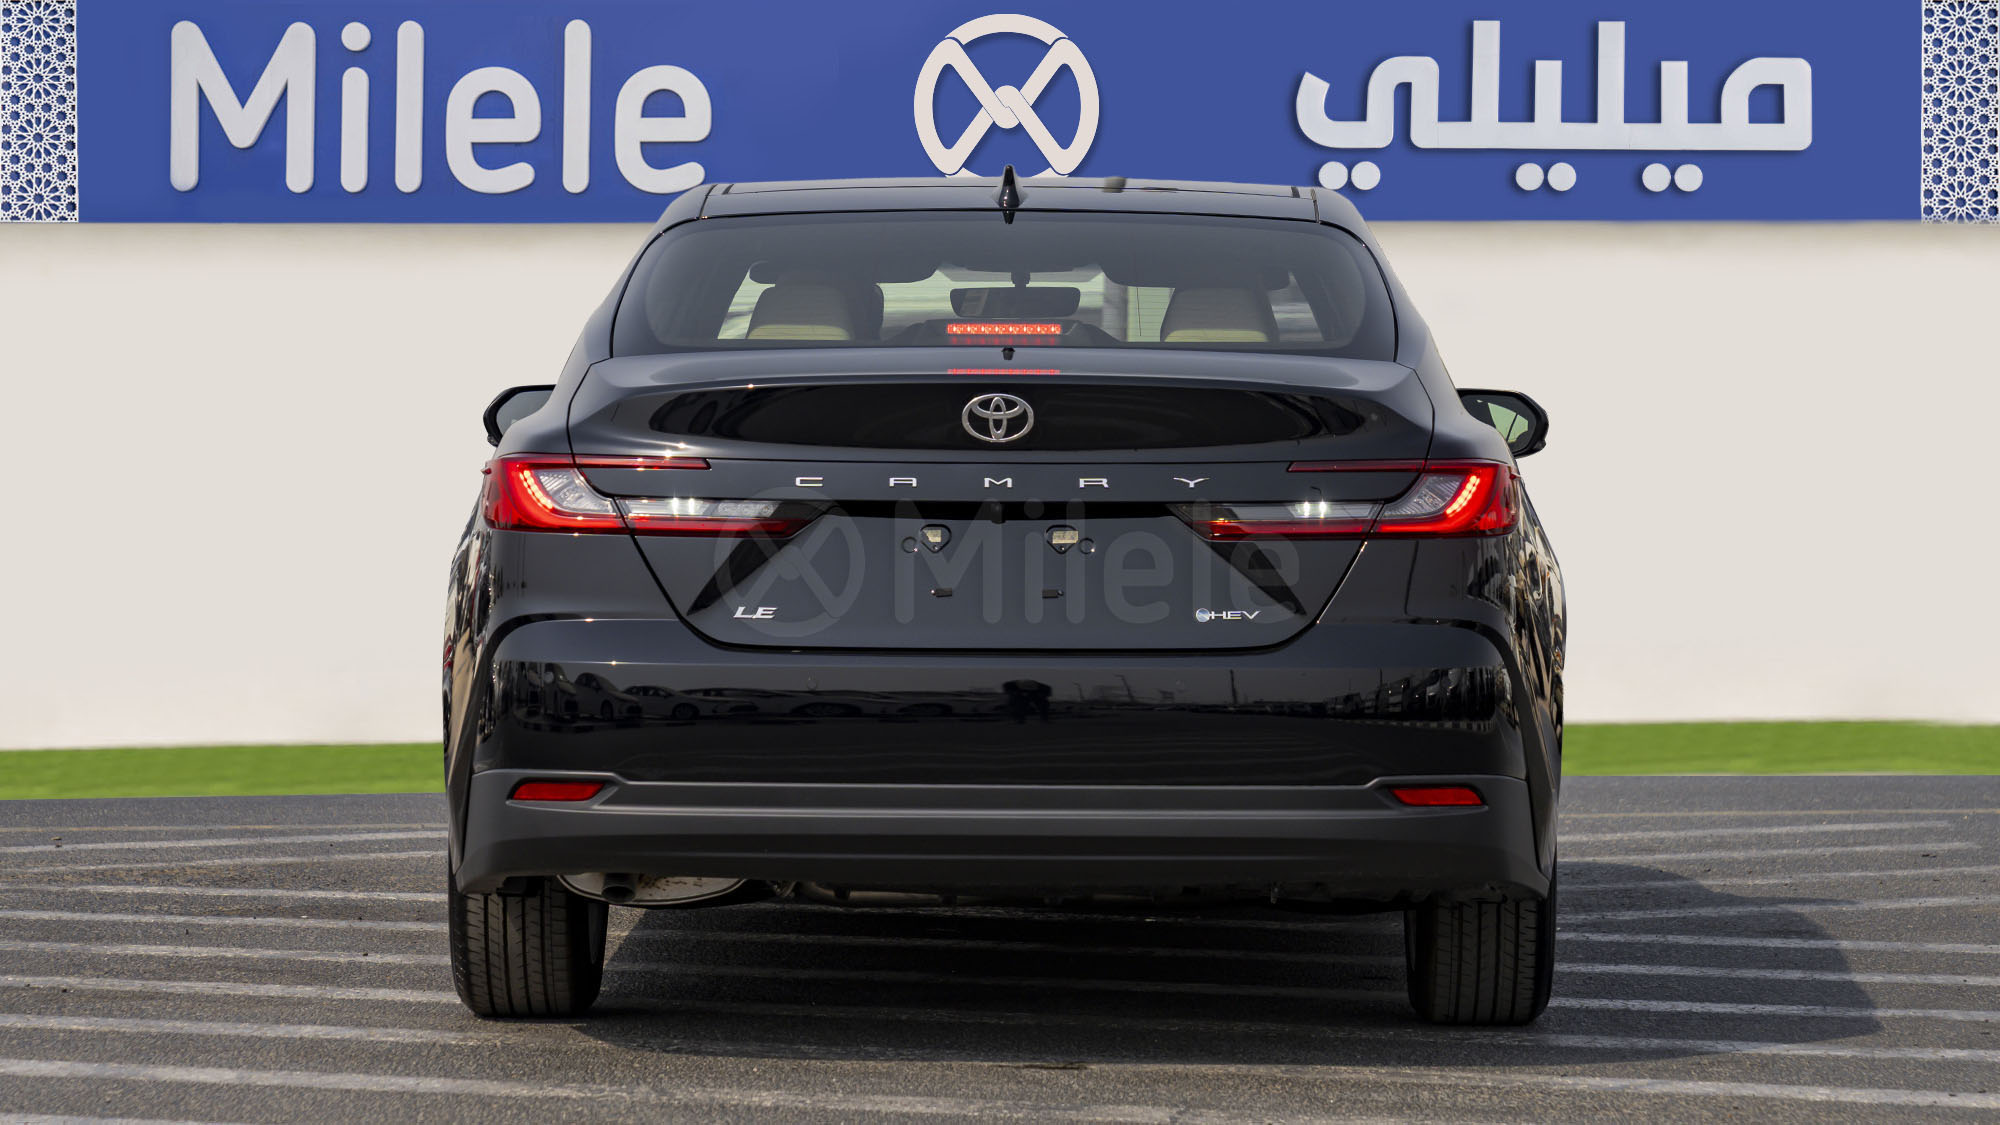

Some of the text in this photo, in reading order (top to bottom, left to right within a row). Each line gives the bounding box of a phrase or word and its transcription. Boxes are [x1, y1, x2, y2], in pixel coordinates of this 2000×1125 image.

[169, 19, 713, 194] Milele
[1296, 20, 1813, 193] ميليلي
[795, 476, 1209, 489] CAMRY
[733, 606, 778, 619] LE
[1210, 610, 1261, 620] HEV
